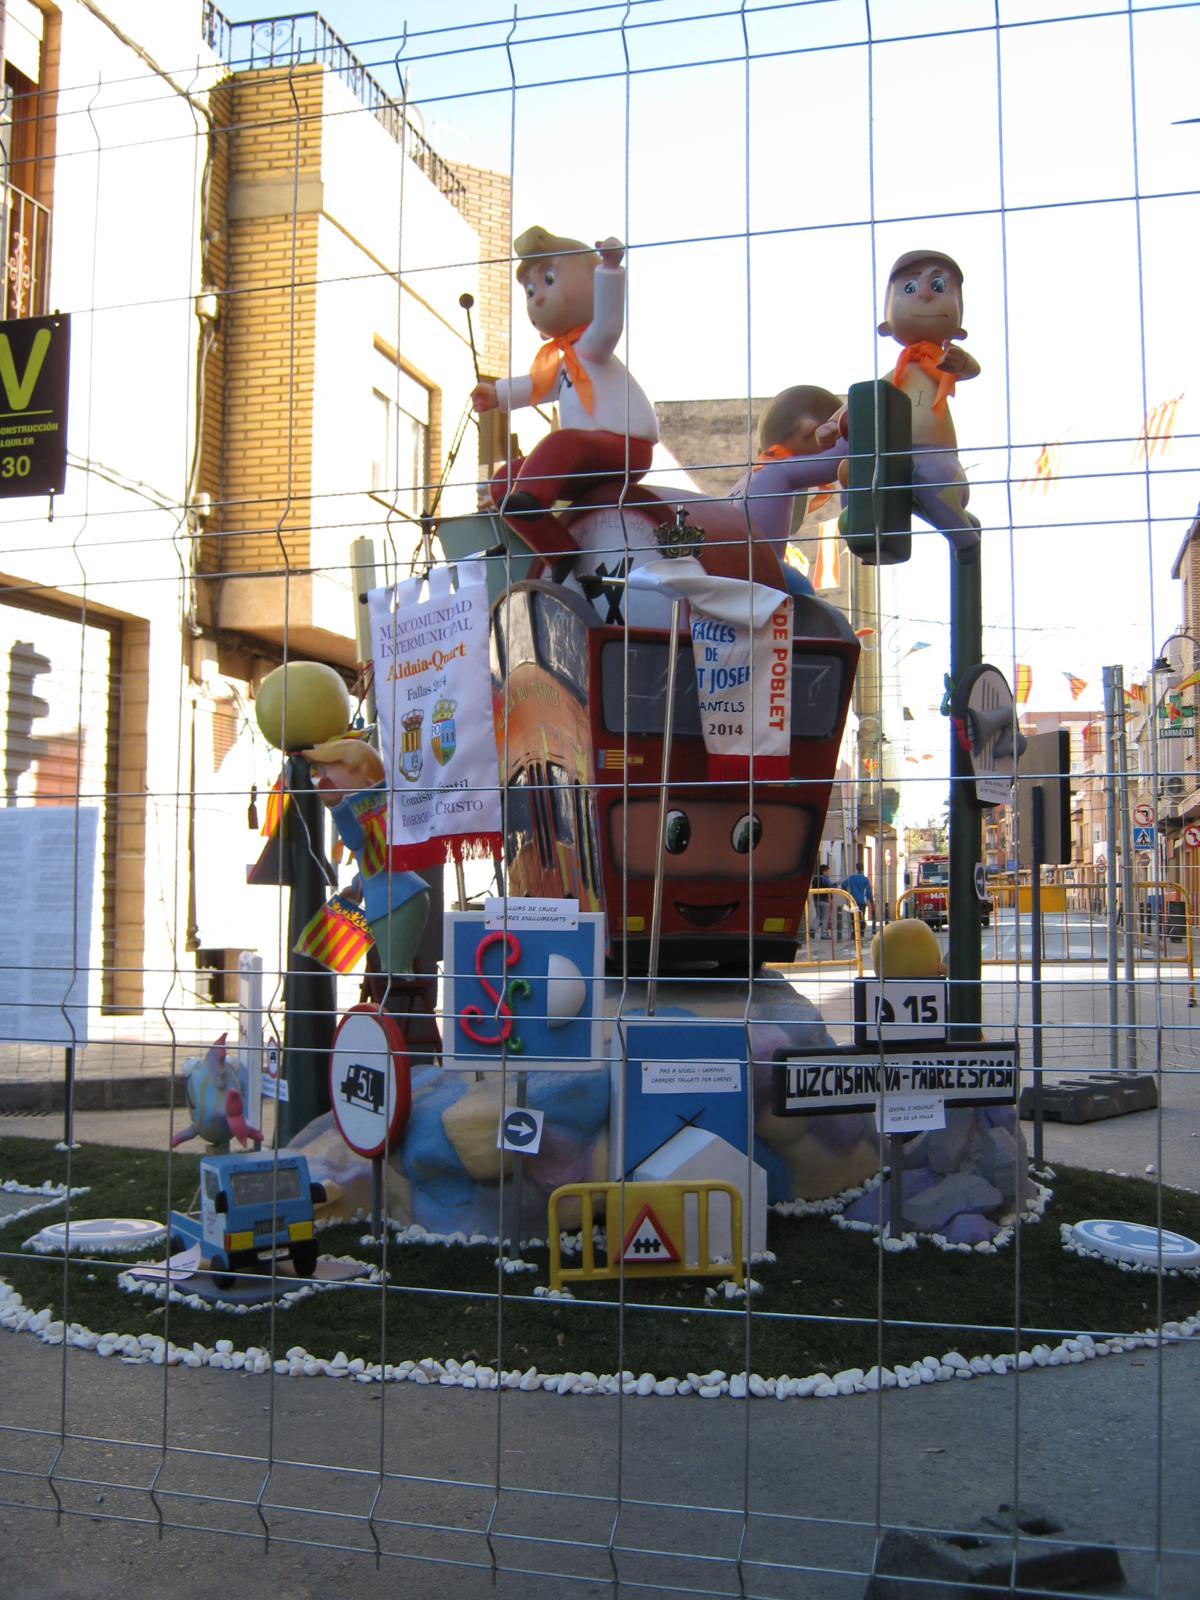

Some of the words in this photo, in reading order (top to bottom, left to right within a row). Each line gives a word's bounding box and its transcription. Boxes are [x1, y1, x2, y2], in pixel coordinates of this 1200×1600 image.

[0, 422, 58, 435] ONSTRUCCIÓN
[0, 437, 34, 448] LQUILER
[1, 456, 31, 478] 30
[692, 620, 736, 643] FALLES
[772, 613, 788, 641] DE
[705, 647, 718, 662] DE
[407, 686, 432, 700] Fallas
[768, 648, 788, 732] POBLET
[699, 701, 745, 712] ANTILS
[708, 723, 744, 735] 2014
[435, 800, 484, 816] CRISTO
[902, 995, 939, 1024] 15
